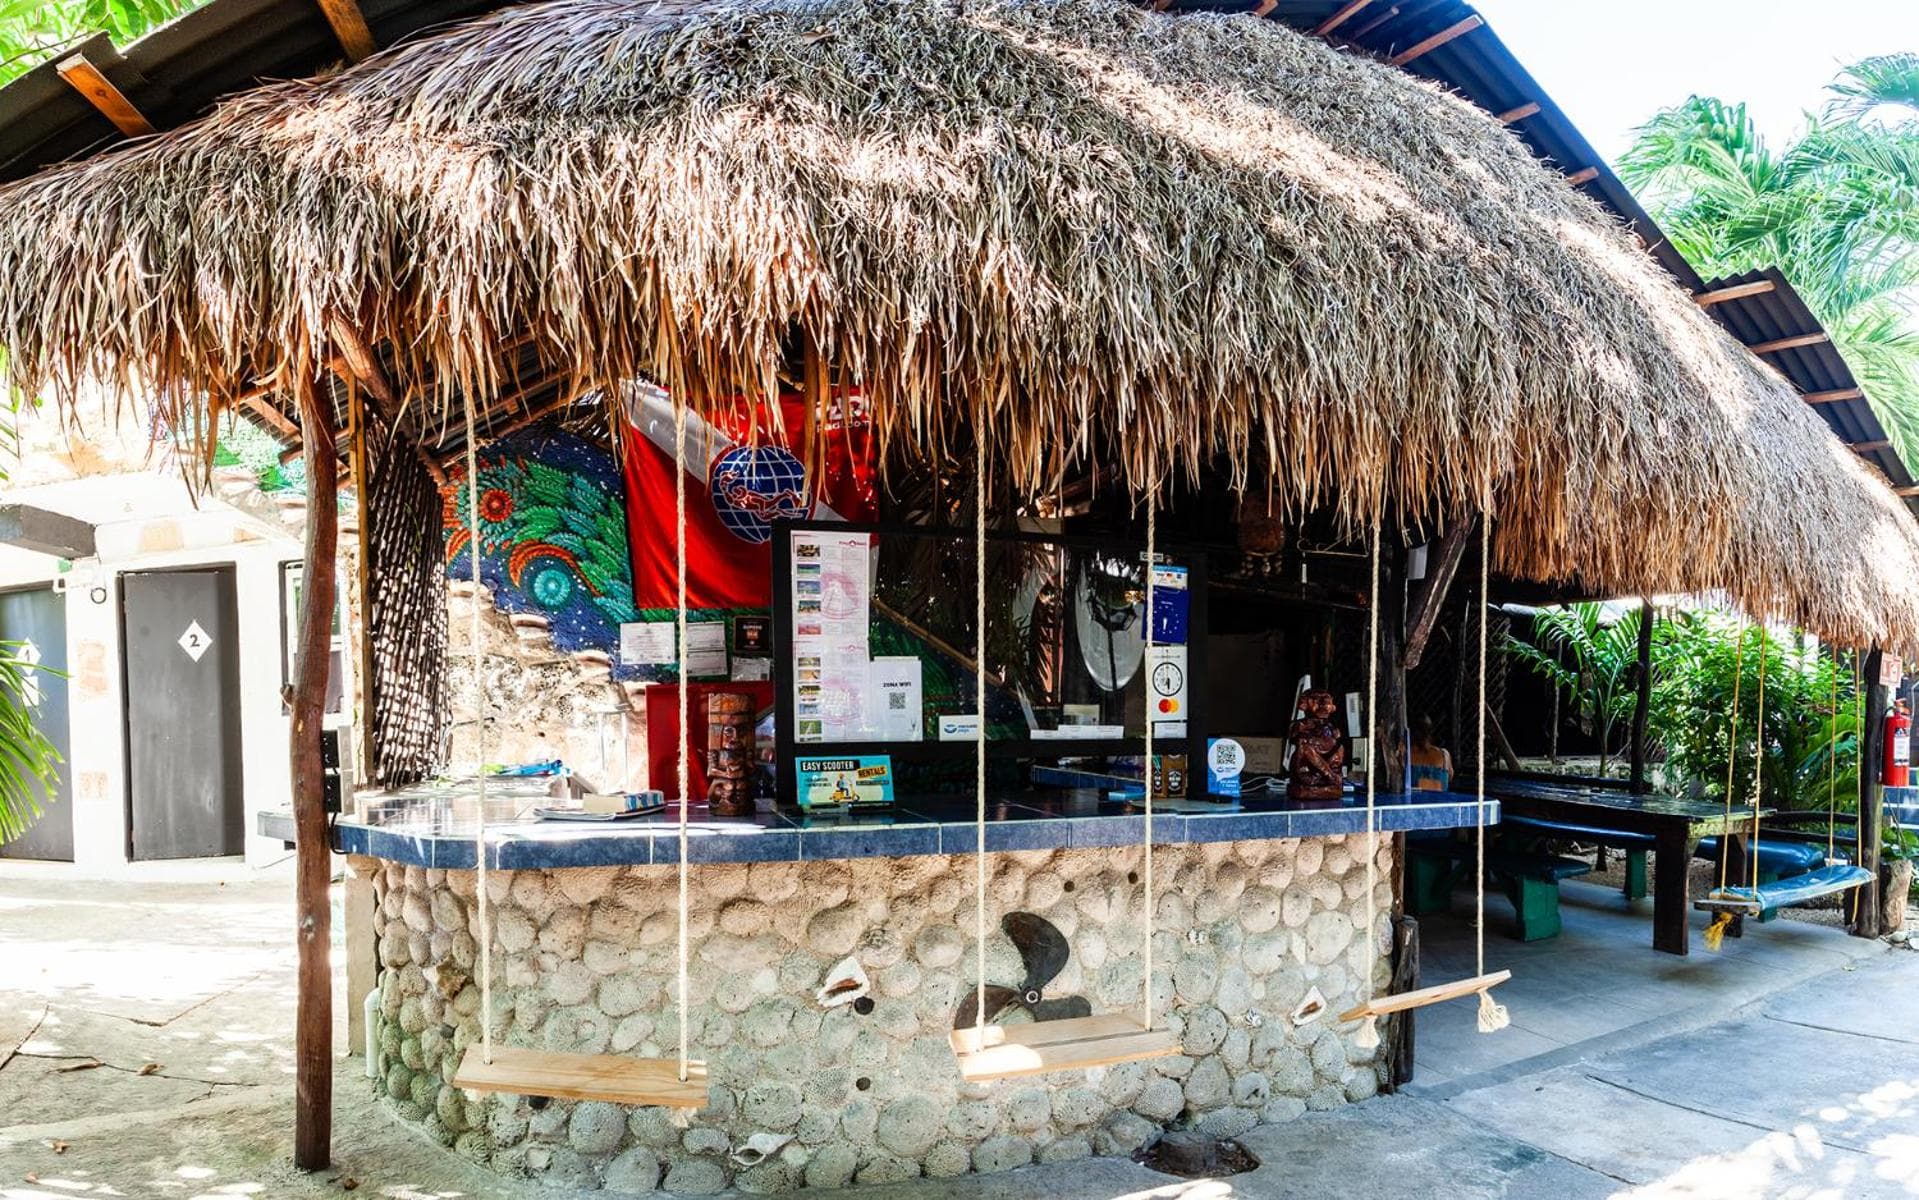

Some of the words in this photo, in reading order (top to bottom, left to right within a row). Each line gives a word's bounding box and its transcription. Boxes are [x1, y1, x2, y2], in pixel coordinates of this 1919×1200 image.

[190, 634, 200, 648] 2
[25, 649, 31, 662] 1
[802, 760, 821, 771] EASY
[822, 760, 855, 770] SCOOTER
[857, 766, 886, 778] RENTALS
